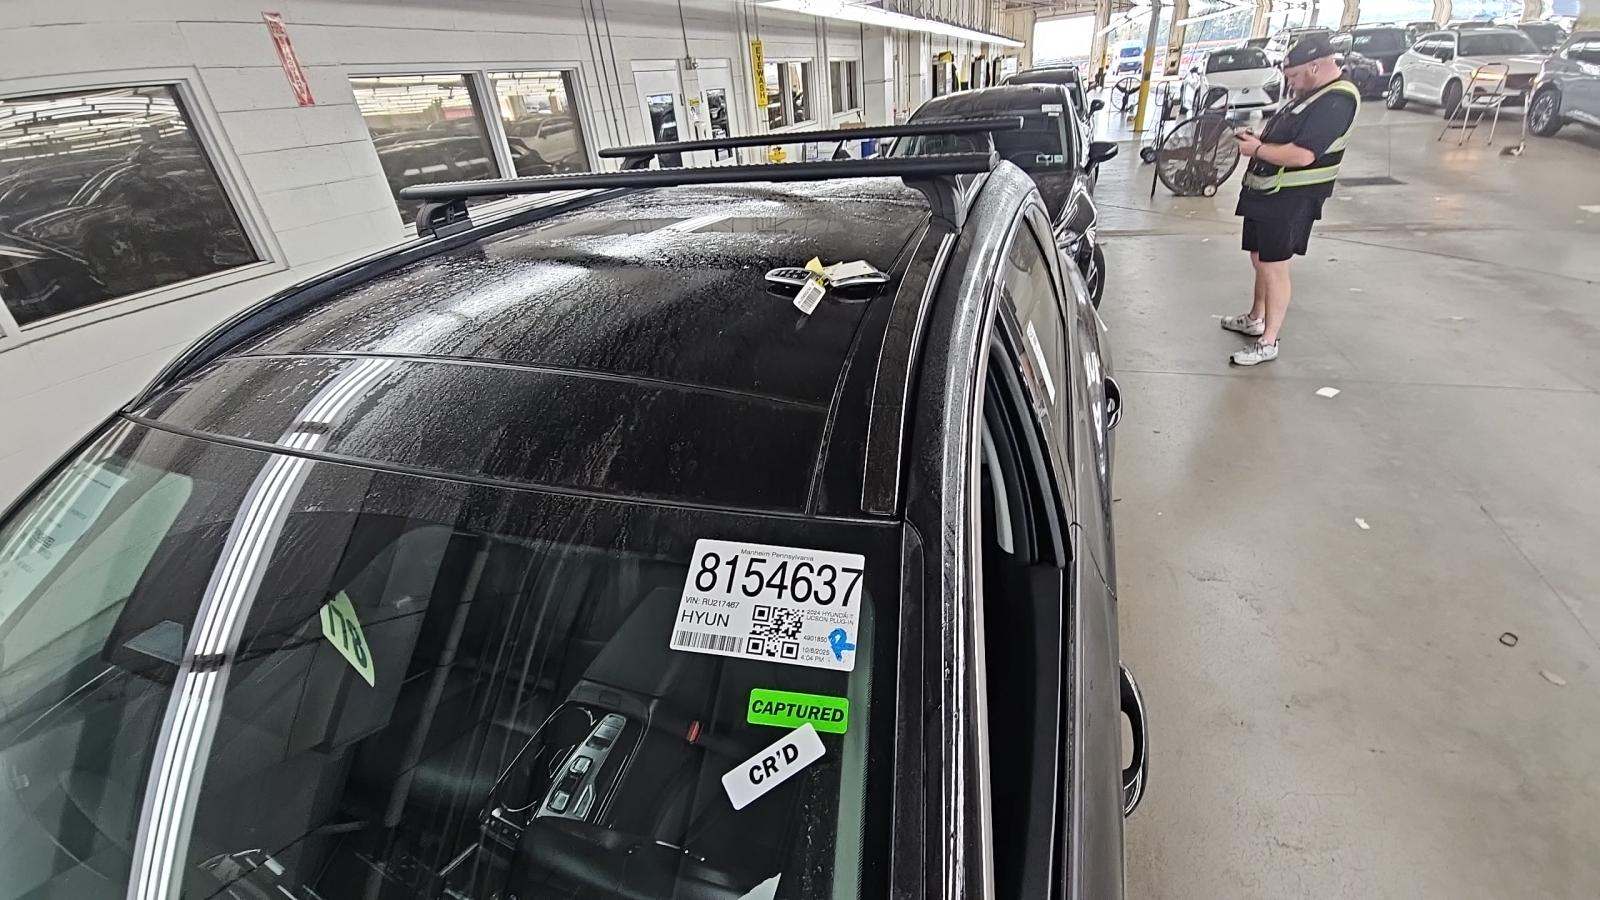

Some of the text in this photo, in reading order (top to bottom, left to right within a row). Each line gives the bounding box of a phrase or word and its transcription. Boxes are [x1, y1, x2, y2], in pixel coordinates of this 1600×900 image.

[755, 46, 766, 99] EYEWASH
[740, 548, 815, 562] Manheim Pennsylvania
[694, 552, 864, 607] 8154637
[685, 597, 700, 605] VIN:
[681, 609, 730, 628] HYUN
[751, 699, 845, 723] CAPTURED
[748, 743, 799, 785] CR'D
